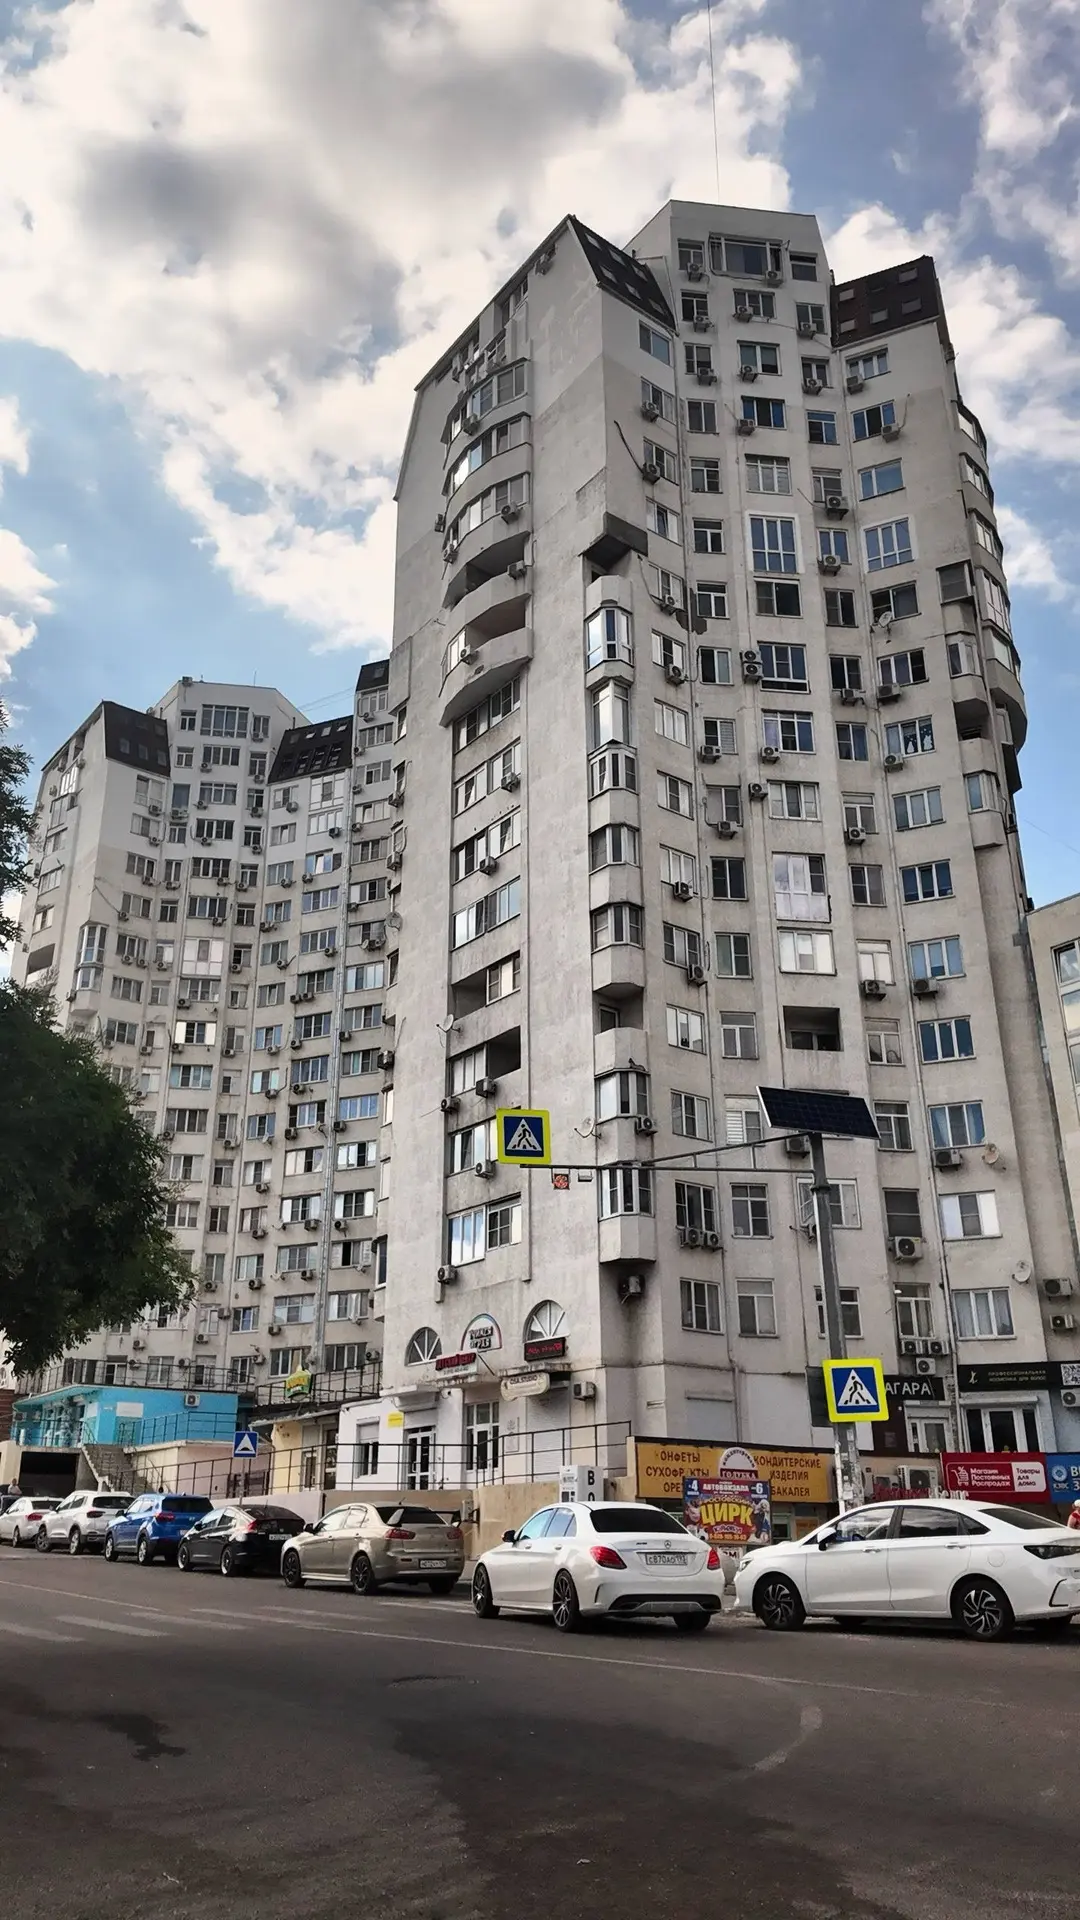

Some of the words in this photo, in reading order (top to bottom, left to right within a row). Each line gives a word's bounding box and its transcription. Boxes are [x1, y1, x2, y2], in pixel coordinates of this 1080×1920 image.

[885, 1382, 932, 1395] АГАРА
[657, 1452, 700, 1463] ОНФЕТЫ
[754, 1455, 822, 1469] КОНДИТЕРСКИЕ
[646, 1466, 710, 1478] СУХОФРКТЫ
[769, 1470, 809, 1481] ИЗДЕЛИЯ
[1016, 1467, 1041, 1475] Товары
[663, 1481, 683, 1493] ОРЕ
[771, 1486, 811, 1497] БАКАЛЕЯ
[700, 1502, 754, 1527] ЦИРК
